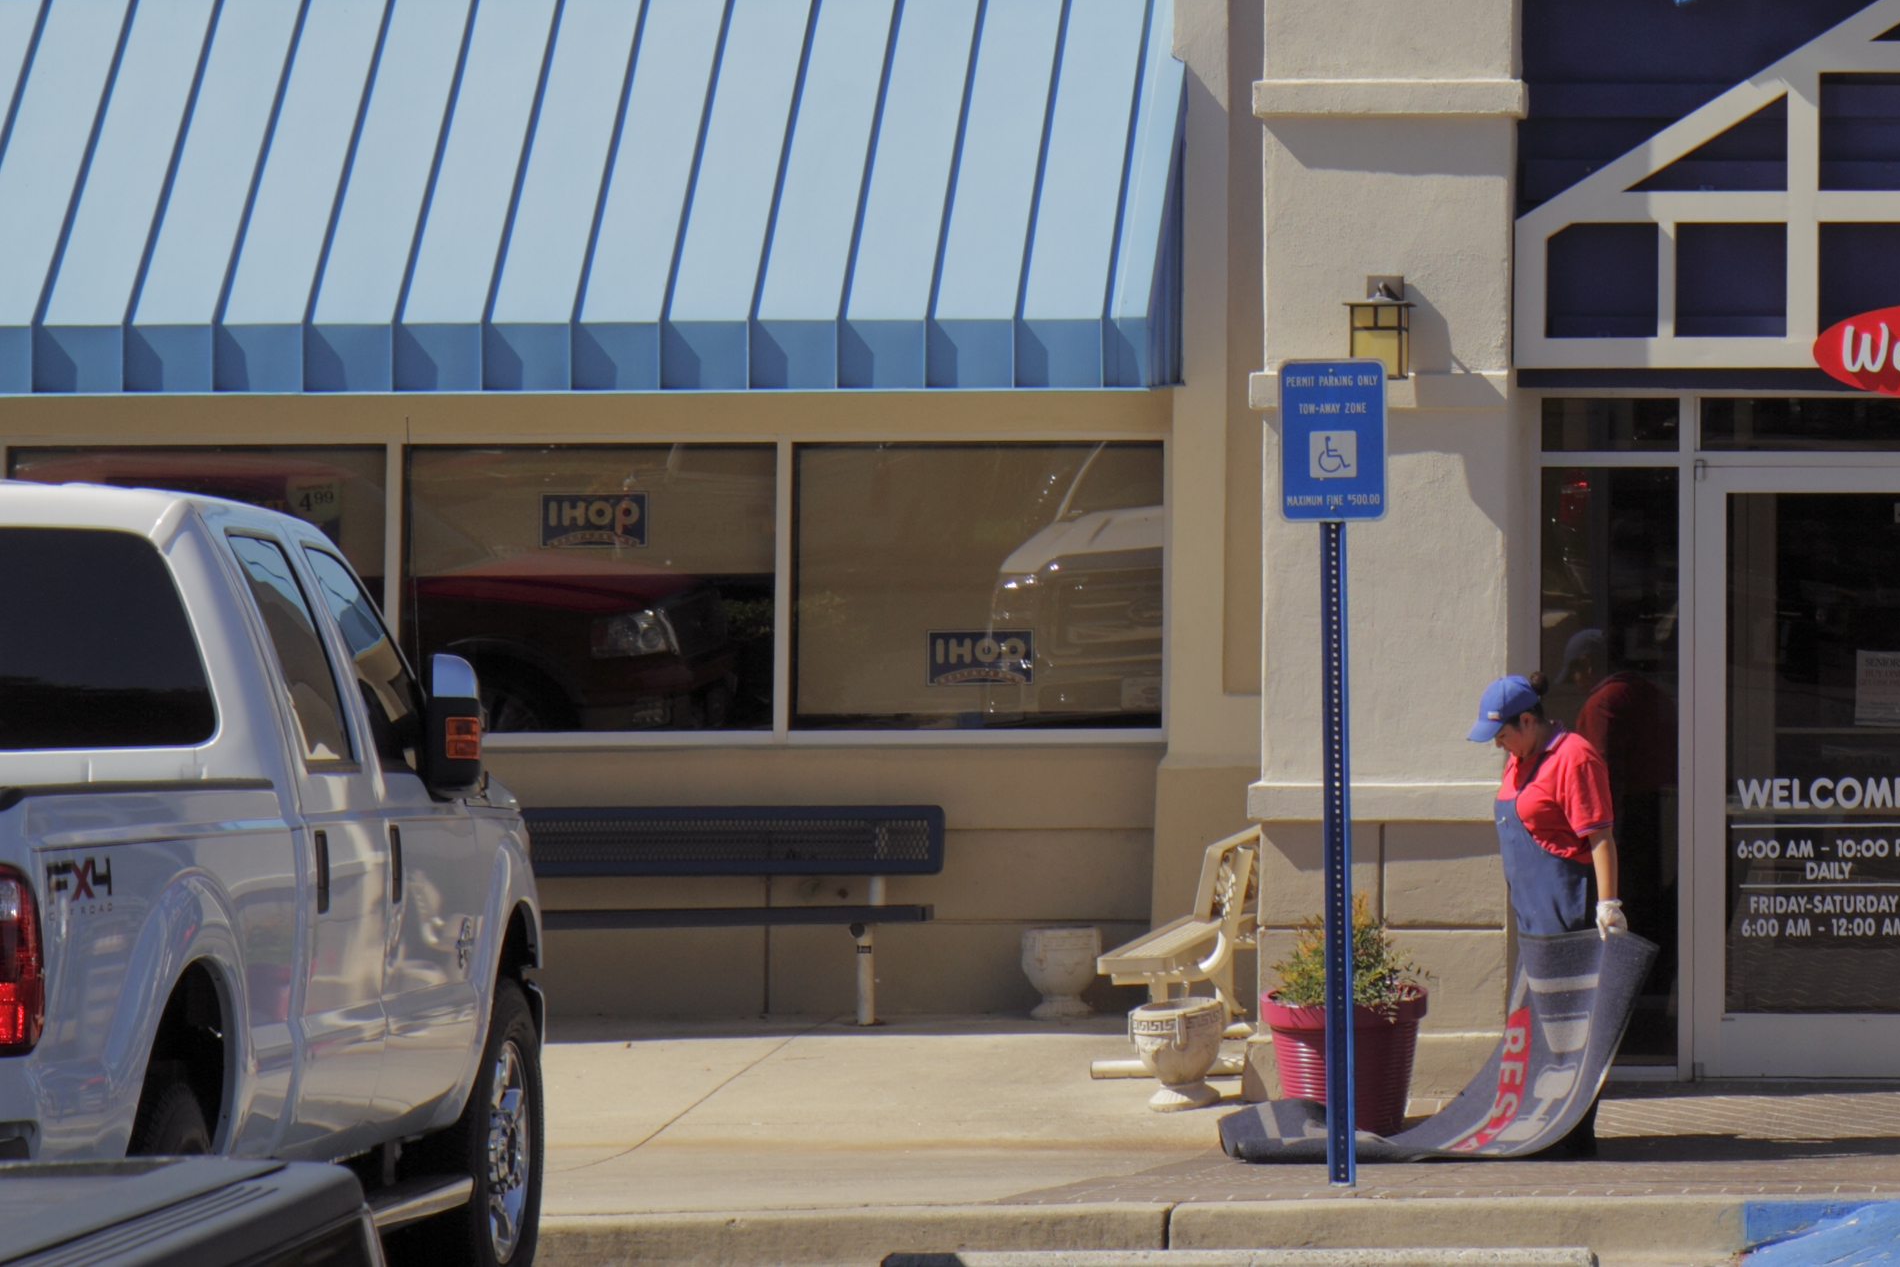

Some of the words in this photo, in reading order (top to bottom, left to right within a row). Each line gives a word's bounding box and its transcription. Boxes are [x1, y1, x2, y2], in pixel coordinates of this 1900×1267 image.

[1286, 376, 1315, 387] PERMIT
[1319, 375, 1353, 387] PARKING
[1358, 375, 1378, 386] ONLY
[1299, 403, 1341, 415] TOW-AWAY
[1345, 402, 1367, 414] ZONE
[1287, 495, 1323, 506] MAXIMUM
[1326, 494, 1344, 505] FINE
[1347, 493, 1380, 505] $500.00
[548, 500, 640, 535] IHOP
[936, 638, 1026, 671] IHOP
[1737, 839, 1780, 859] 6:00
[1786, 839, 1815, 858] AM
[1836, 839, 1889, 858] 10:00
[46, 855, 112, 904] FX4
[1805, 861, 1852, 880] DAILY
[1750, 895, 1899, 914] FRIDAY-SATURDAY
[1741, 918, 1779, 937] 6:00
[1785, 918, 1811, 937] AM
[1832, 918, 1876, 937] 12:00
